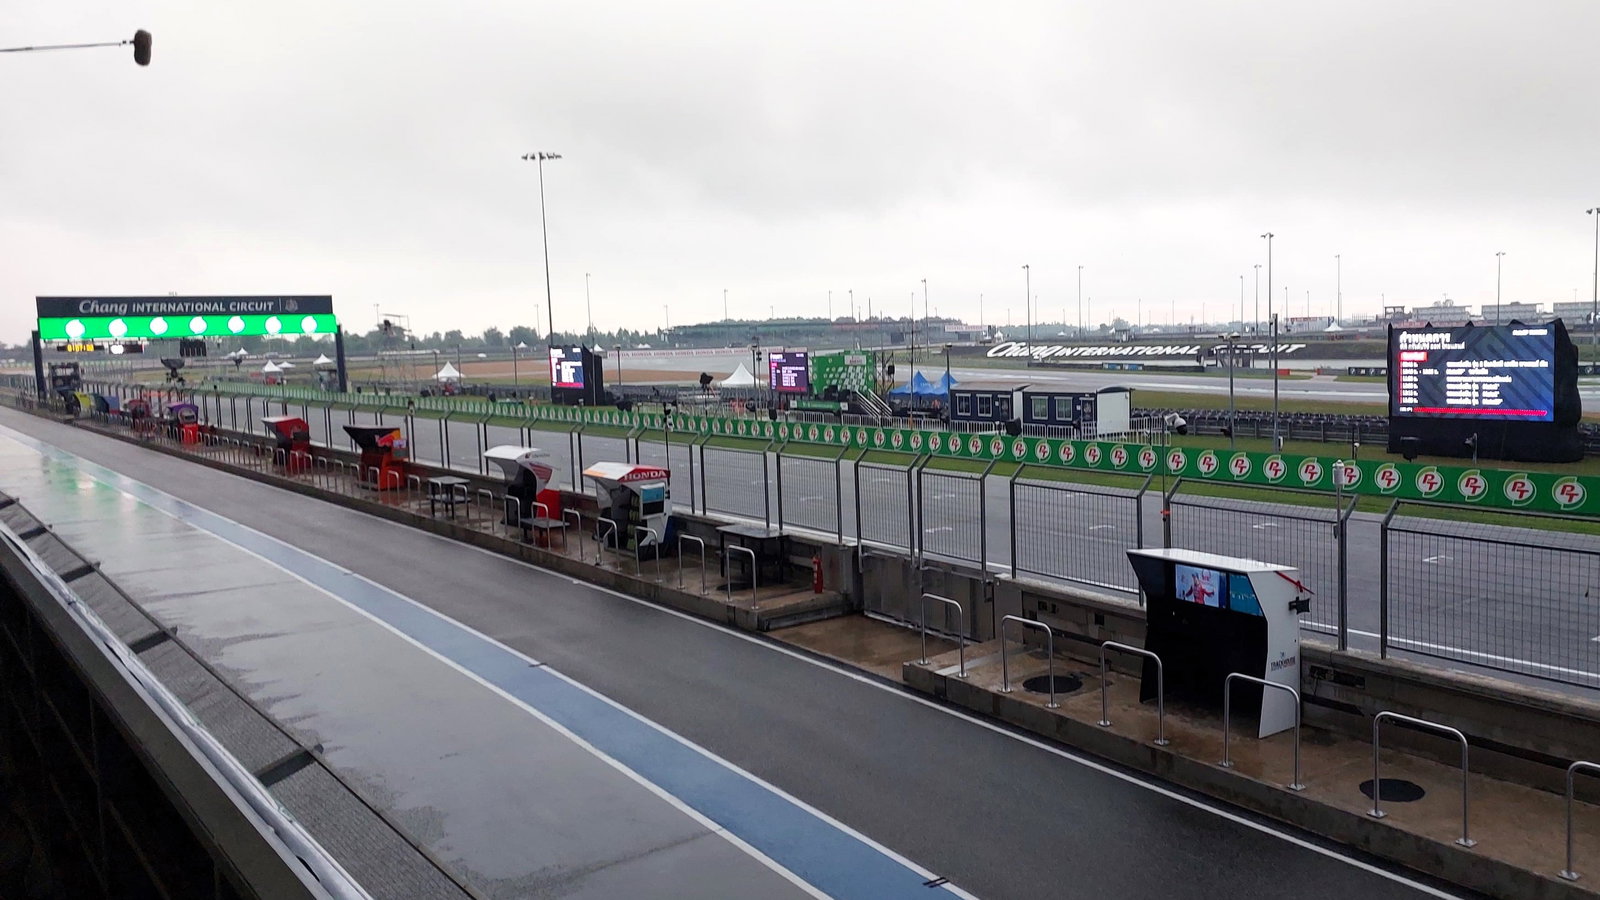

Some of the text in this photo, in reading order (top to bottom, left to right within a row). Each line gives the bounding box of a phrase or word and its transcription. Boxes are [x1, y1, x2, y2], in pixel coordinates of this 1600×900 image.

[78, 299, 274, 316] Chang INTERNATIONAL CIRCUIT
[986, 341, 1061, 359] Chang
[1054, 345, 1201, 357] INTERNATIONAL
[624, 470, 667, 481] HONDA
[994, 442, 1001, 452] PT
[1016, 444, 1024, 454] PT
[1039, 445, 1048, 456] PT
[1062, 447, 1071, 458] PT
[1088, 449, 1097, 460] PT
[1114, 450, 1124, 462] PT
[1143, 452, 1152, 464] PT
[1172, 454, 1181, 467] PT
[1202, 457, 1213, 470] PT
[1234, 459, 1246, 473] PT
[1269, 461, 1281, 477] PT
[1304, 464, 1317, 480] PT
[1343, 467, 1356, 483] PT
[1381, 470, 1395, 487] PT
[1423, 473, 1437, 490] PT
[1465, 477, 1480, 494] PT
[1511, 480, 1527, 499] PT
[1561, 484, 1578, 502] PT
